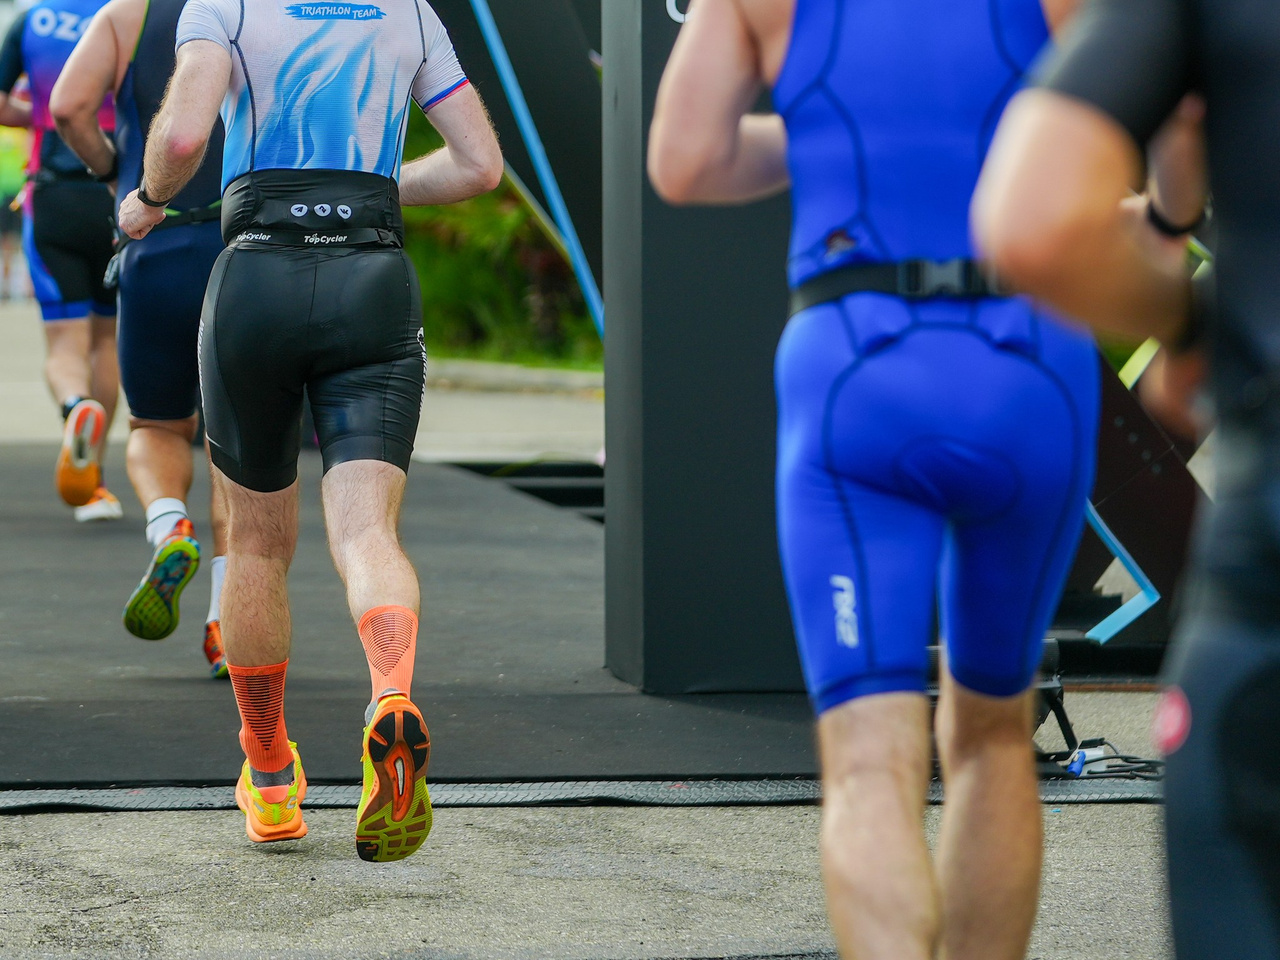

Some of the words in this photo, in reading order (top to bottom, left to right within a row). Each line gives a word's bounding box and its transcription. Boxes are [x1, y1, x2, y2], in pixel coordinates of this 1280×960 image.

[300, 6, 351, 17] TRIATHLON
[352, 8, 378, 20] TEAM
[30, 7, 95, 43] OZ
[236, 230, 272, 242] opCycler
[303, 233, 348, 245] TopCycler
